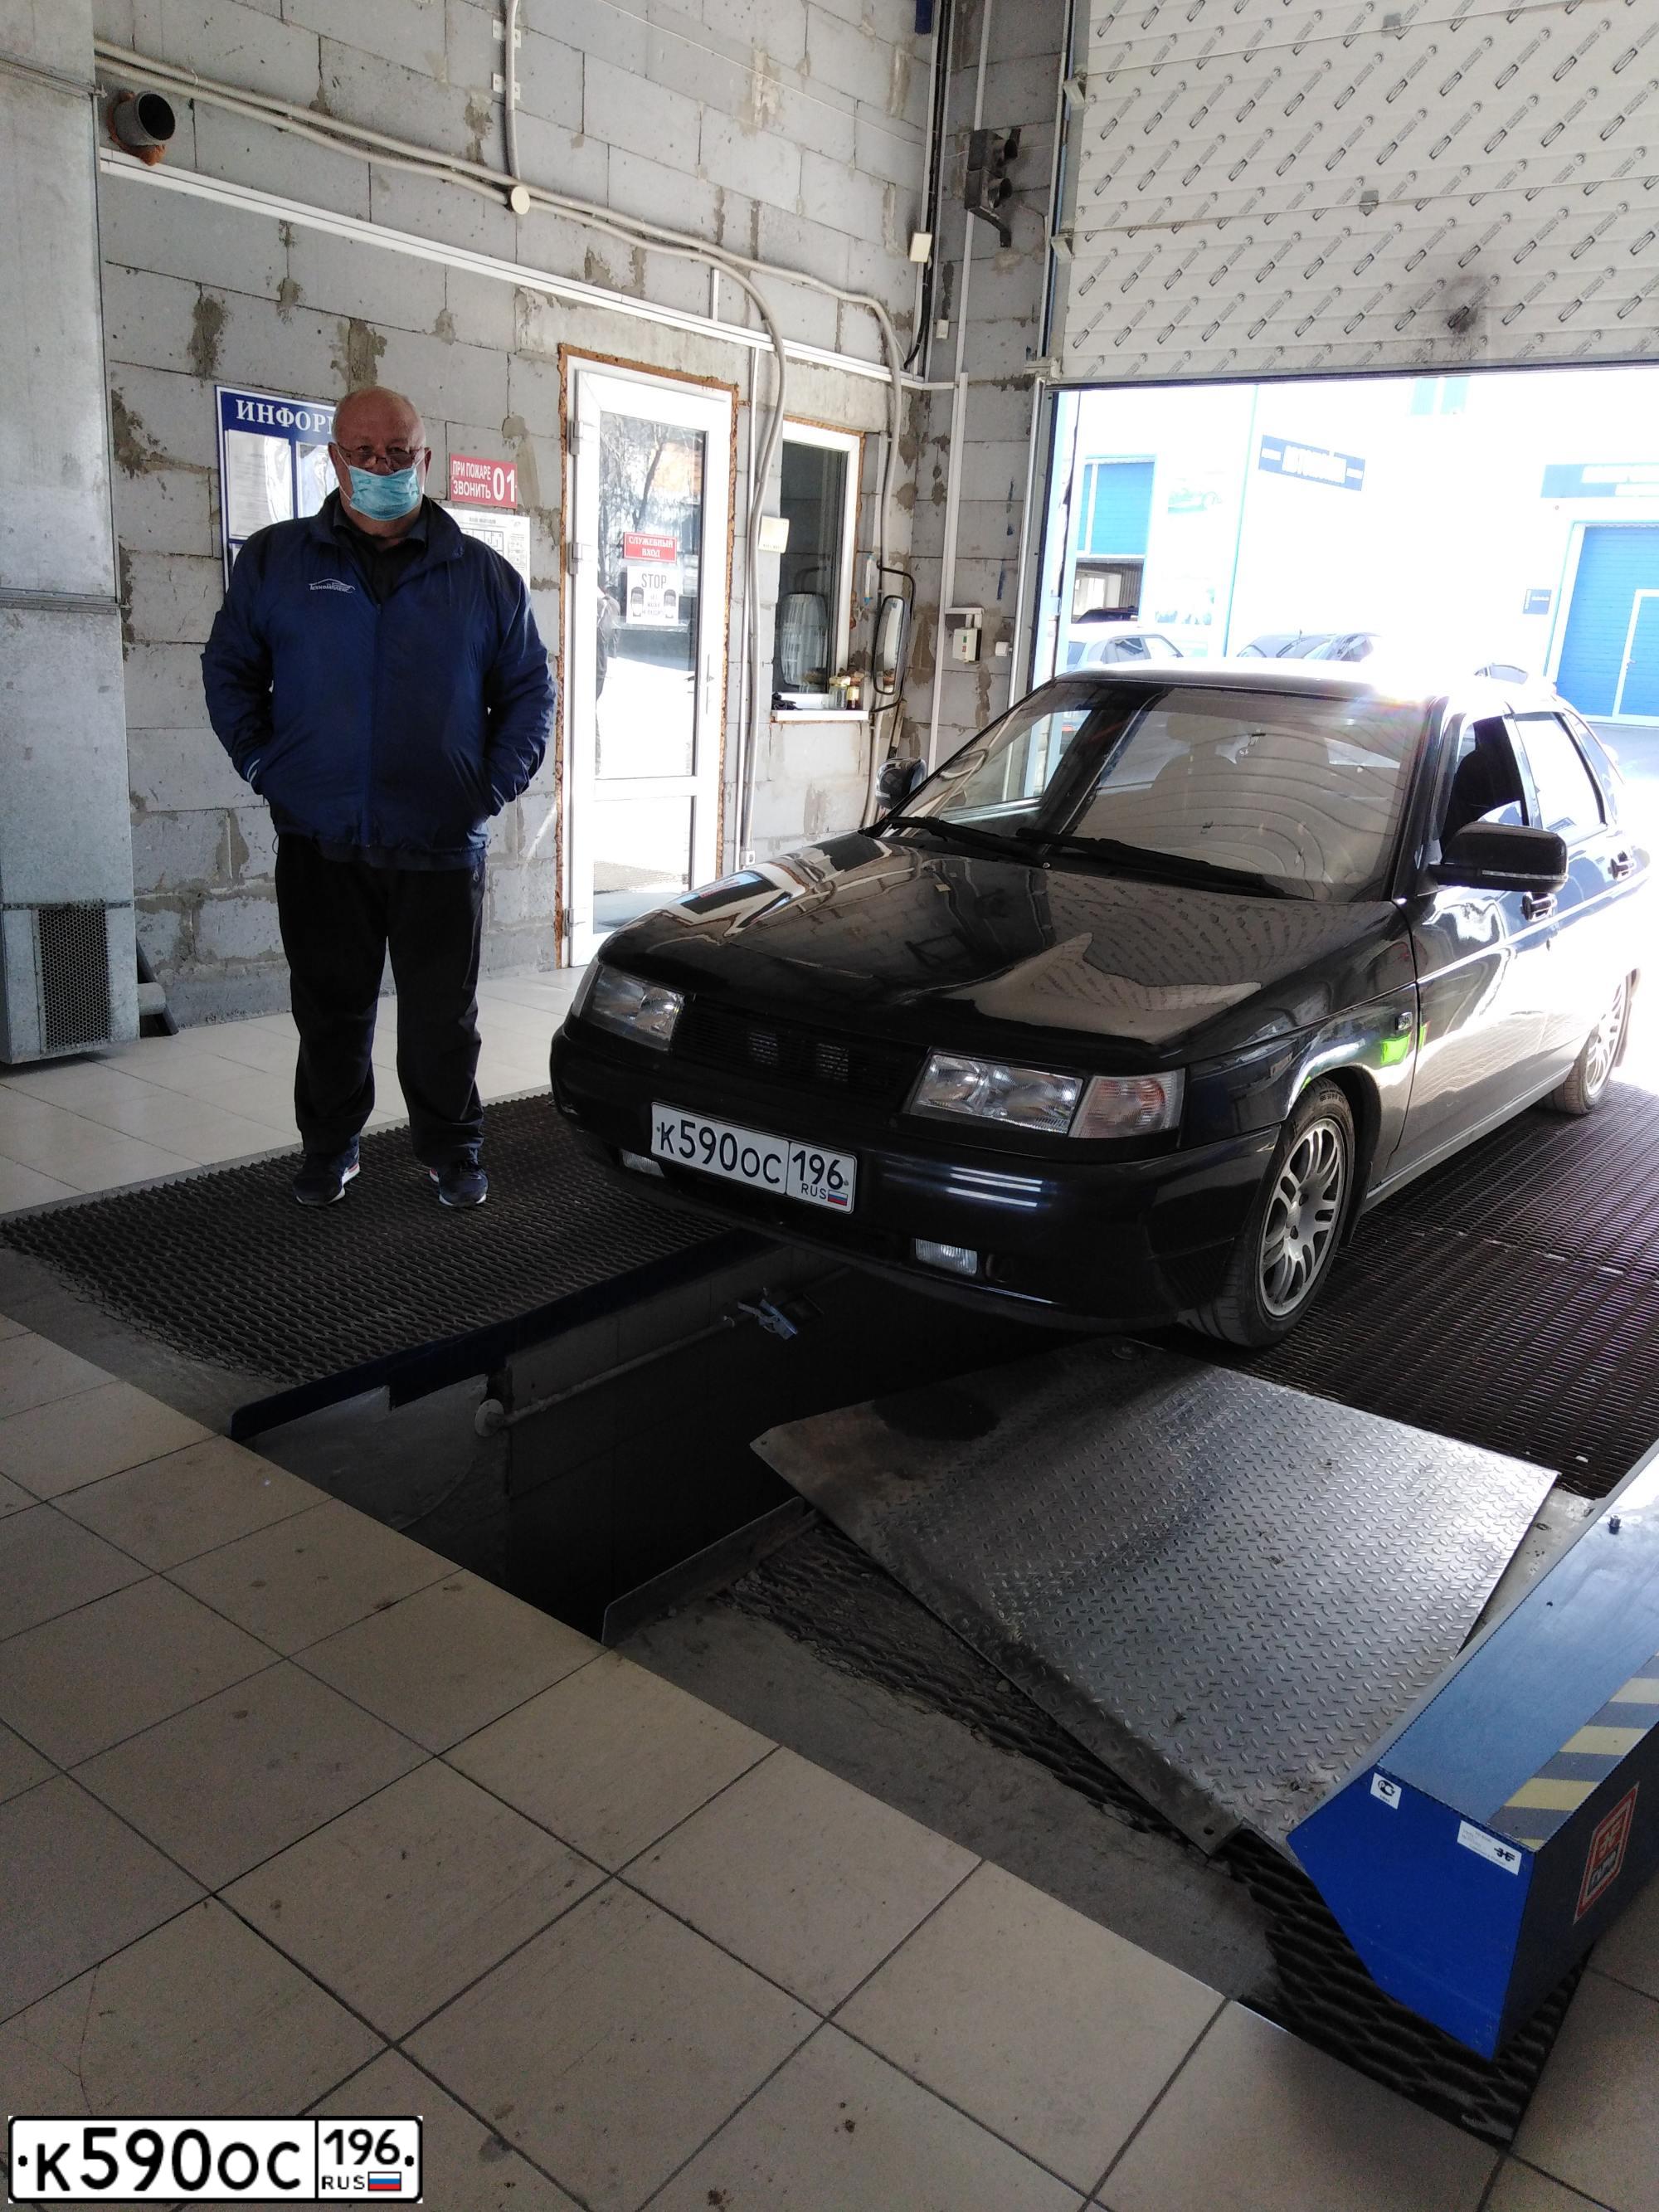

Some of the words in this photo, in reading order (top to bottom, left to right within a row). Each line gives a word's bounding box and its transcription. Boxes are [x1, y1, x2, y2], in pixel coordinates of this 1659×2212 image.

[452, 460, 465, 478] ПРИ
[466, 462, 491, 480] ПОЖАРЕ
[453, 480, 491, 499] ЗВОНИТЬ
[493, 467, 515, 503] 01
[628, 536, 674, 548] СЛУЖЕБНЫЙ
[641, 548, 660, 558] ВХОД
[641, 572, 667, 589] STOP
[792, 1150, 844, 1190] 196
[800, 1183, 827, 1200] RUS
